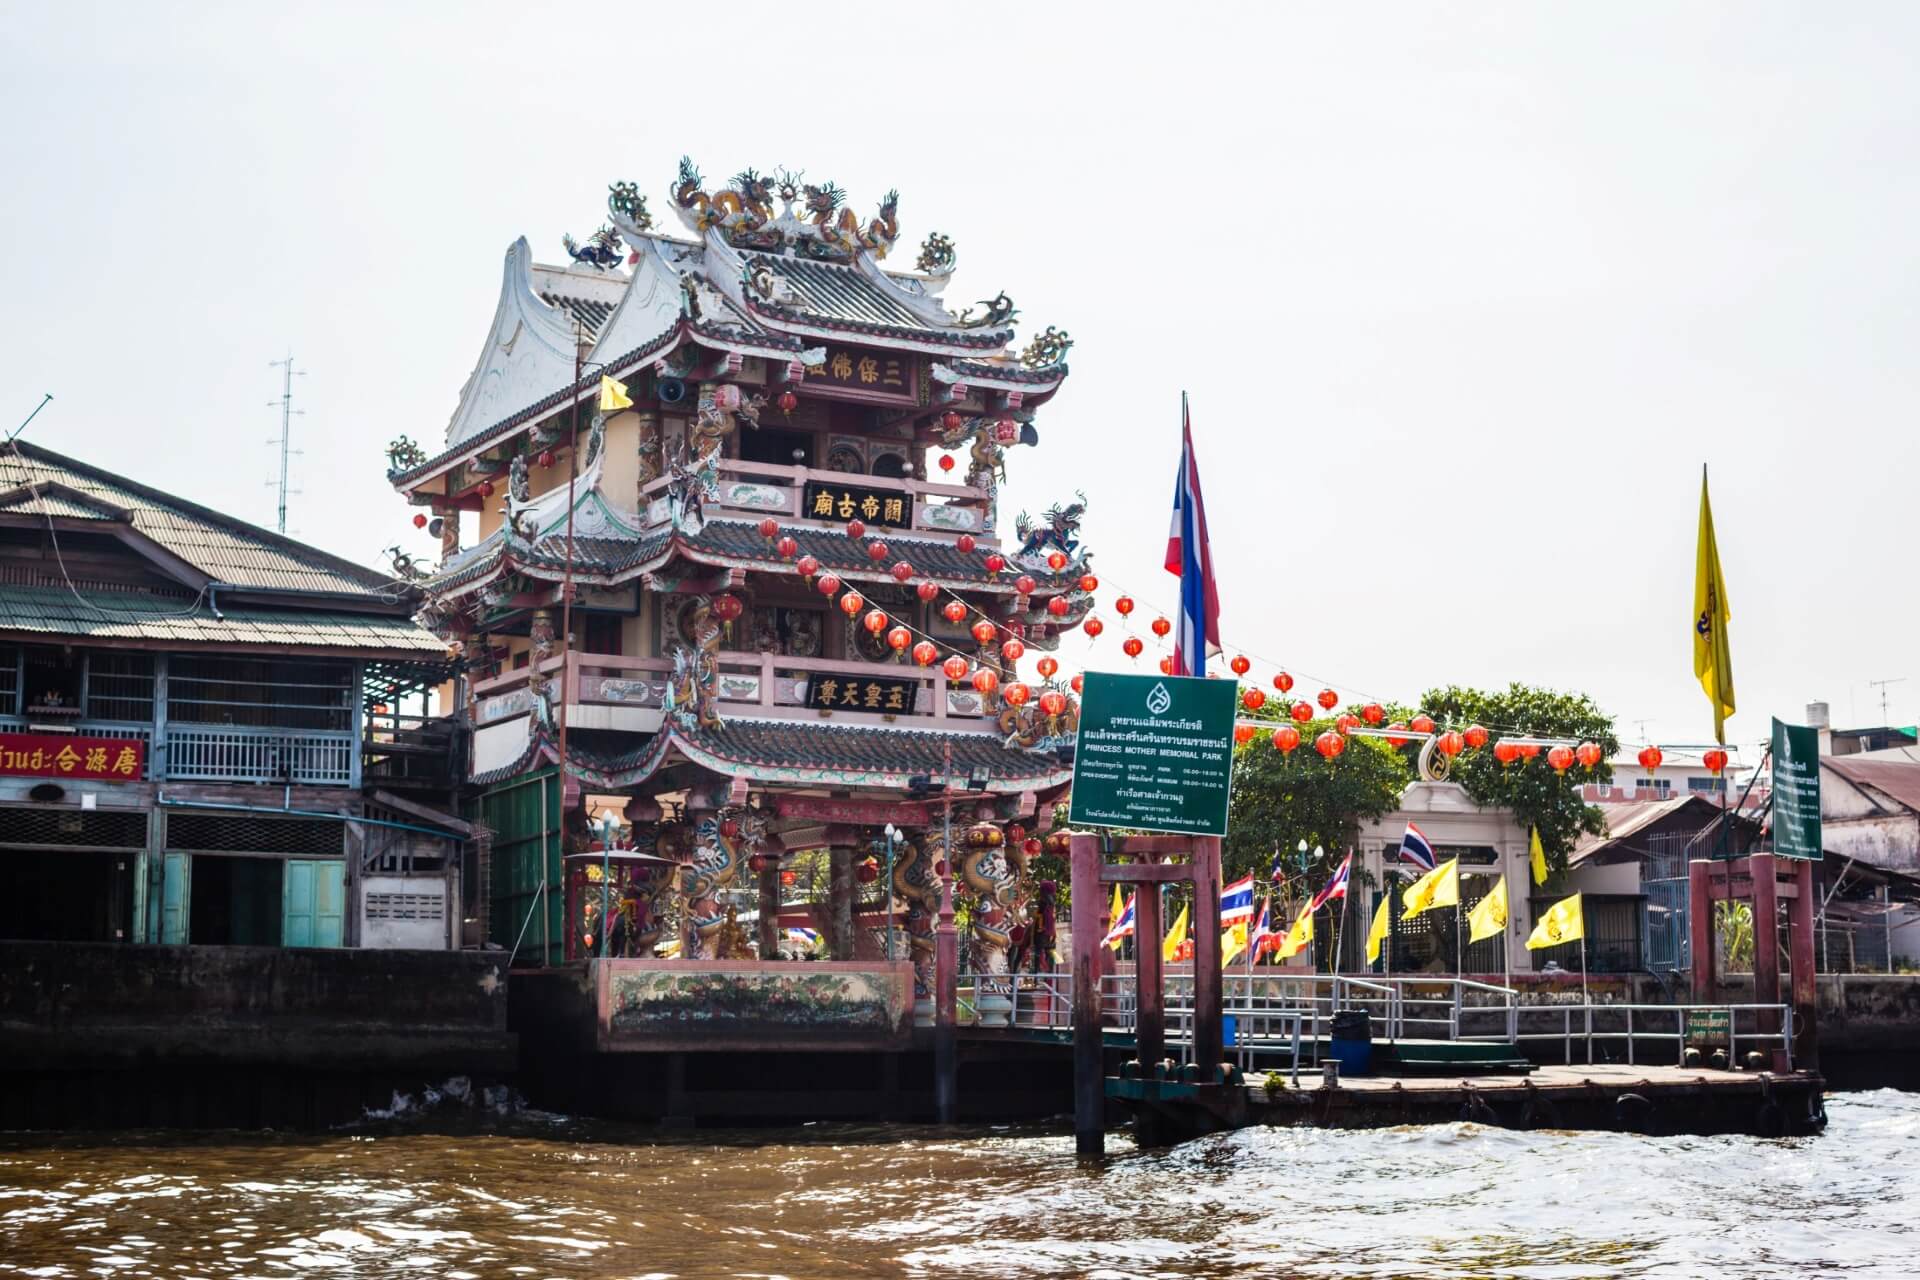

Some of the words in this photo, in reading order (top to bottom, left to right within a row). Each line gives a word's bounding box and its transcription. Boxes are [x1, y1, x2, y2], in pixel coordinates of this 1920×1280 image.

[1085, 743, 1122, 753] PRINCESS
[1124, 746, 1157, 756] MOTHER
[1159, 748, 1199, 759] MEMORIAL
[1201, 752, 1223, 761] PARK
